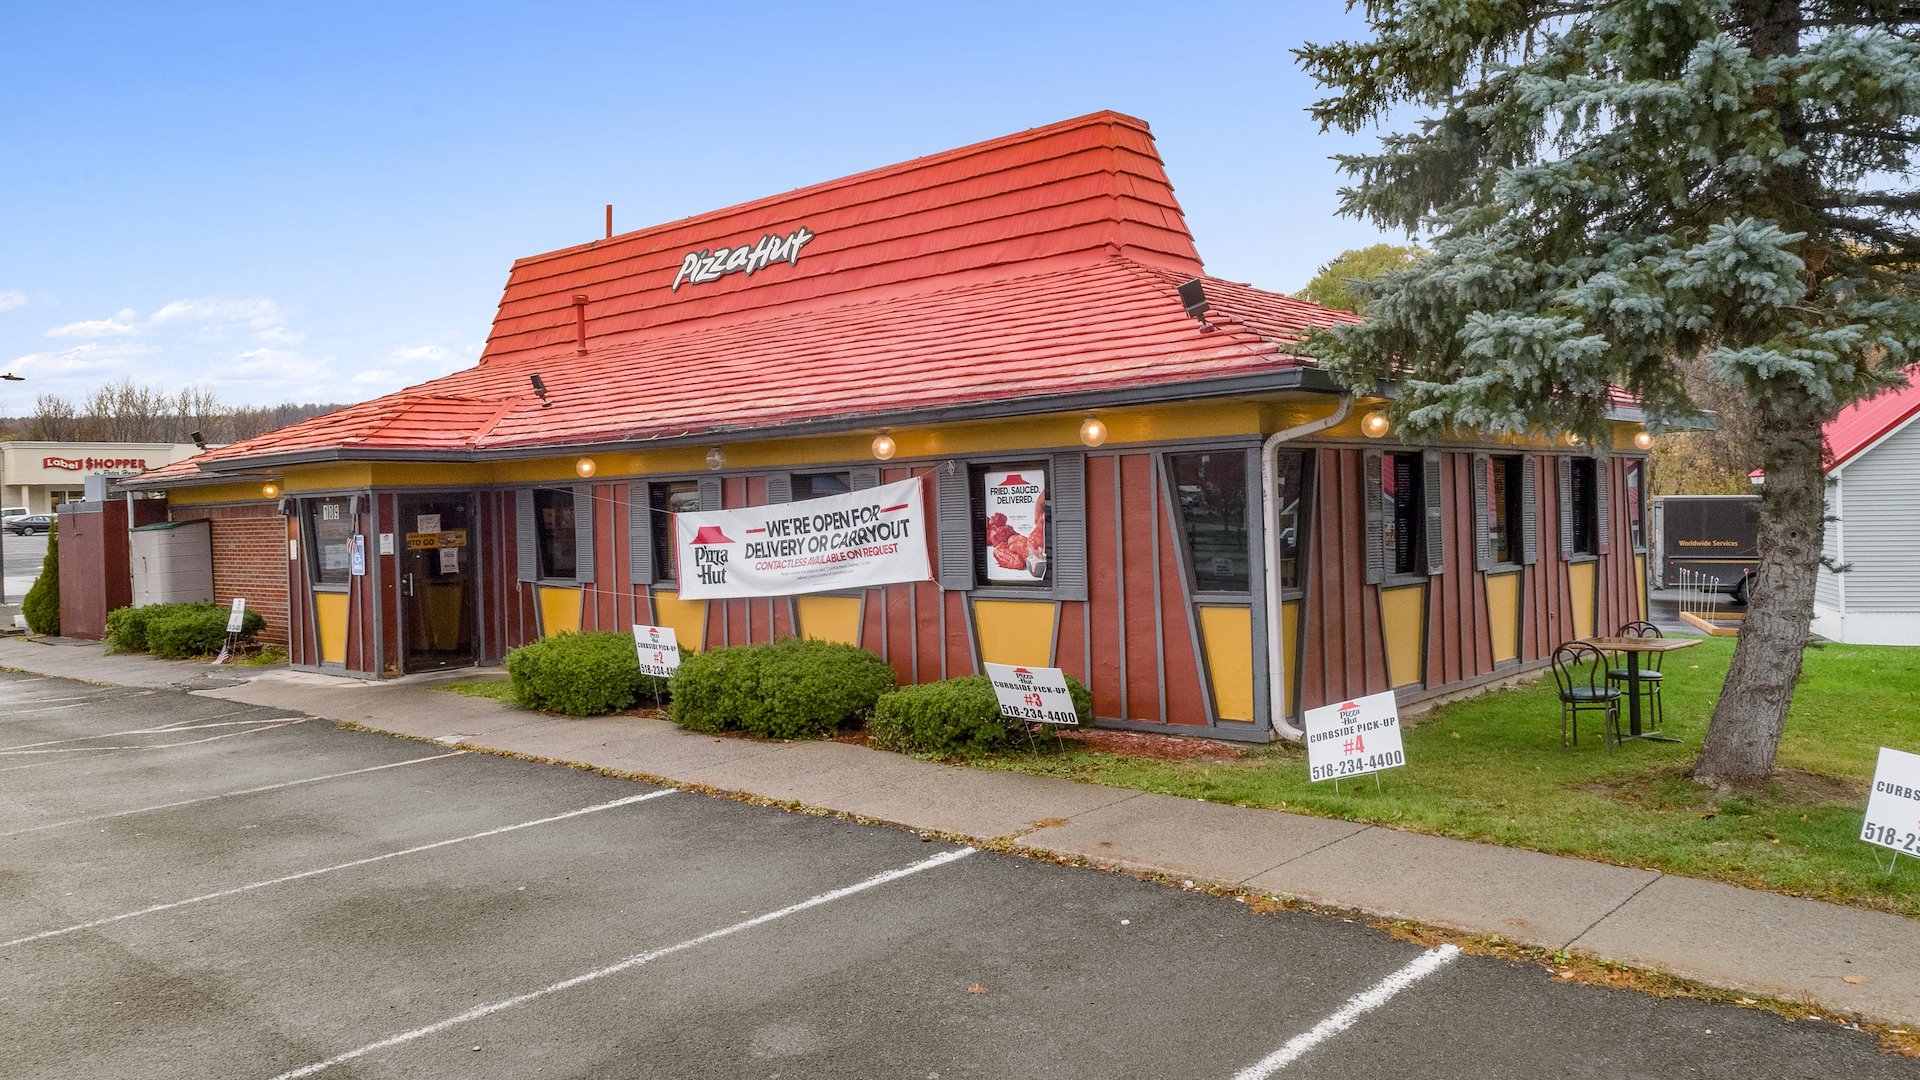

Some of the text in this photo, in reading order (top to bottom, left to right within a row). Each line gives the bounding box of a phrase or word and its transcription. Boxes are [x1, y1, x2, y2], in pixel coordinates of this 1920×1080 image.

[46, 458, 79, 469] Label
[990, 485, 1041, 496] FRIED. SAUCED.
[997, 495, 1035, 505] DELIVERED.
[765, 504, 881, 538] WE'RE OPEN FOR
[744, 519, 910, 559] DELIVERY OR CARRYOUT
[694, 545, 729, 567] Pizza
[755, 557, 807, 571] CONTACTLESS
[807, 551, 847, 566] AVAILABLE
[847, 549, 863, 560] ON
[863, 543, 899, 558] REQUEST
[697, 563, 727, 586] Hut
[653, 651, 664, 664] #2
[993, 680, 1067, 694] CURBSIDE PICK-UP
[1023, 693, 1043, 708] #3
[1001, 704, 1076, 723] 518-234-4400
[1340, 708, 1360, 720] Pizza
[1341, 716, 1358, 726] Hut
[1310, 717, 1396, 743] CURBSIDE PICK-UP
[1343, 734, 1365, 756] #4
[1313, 750, 1402, 779] 518-234-4400
